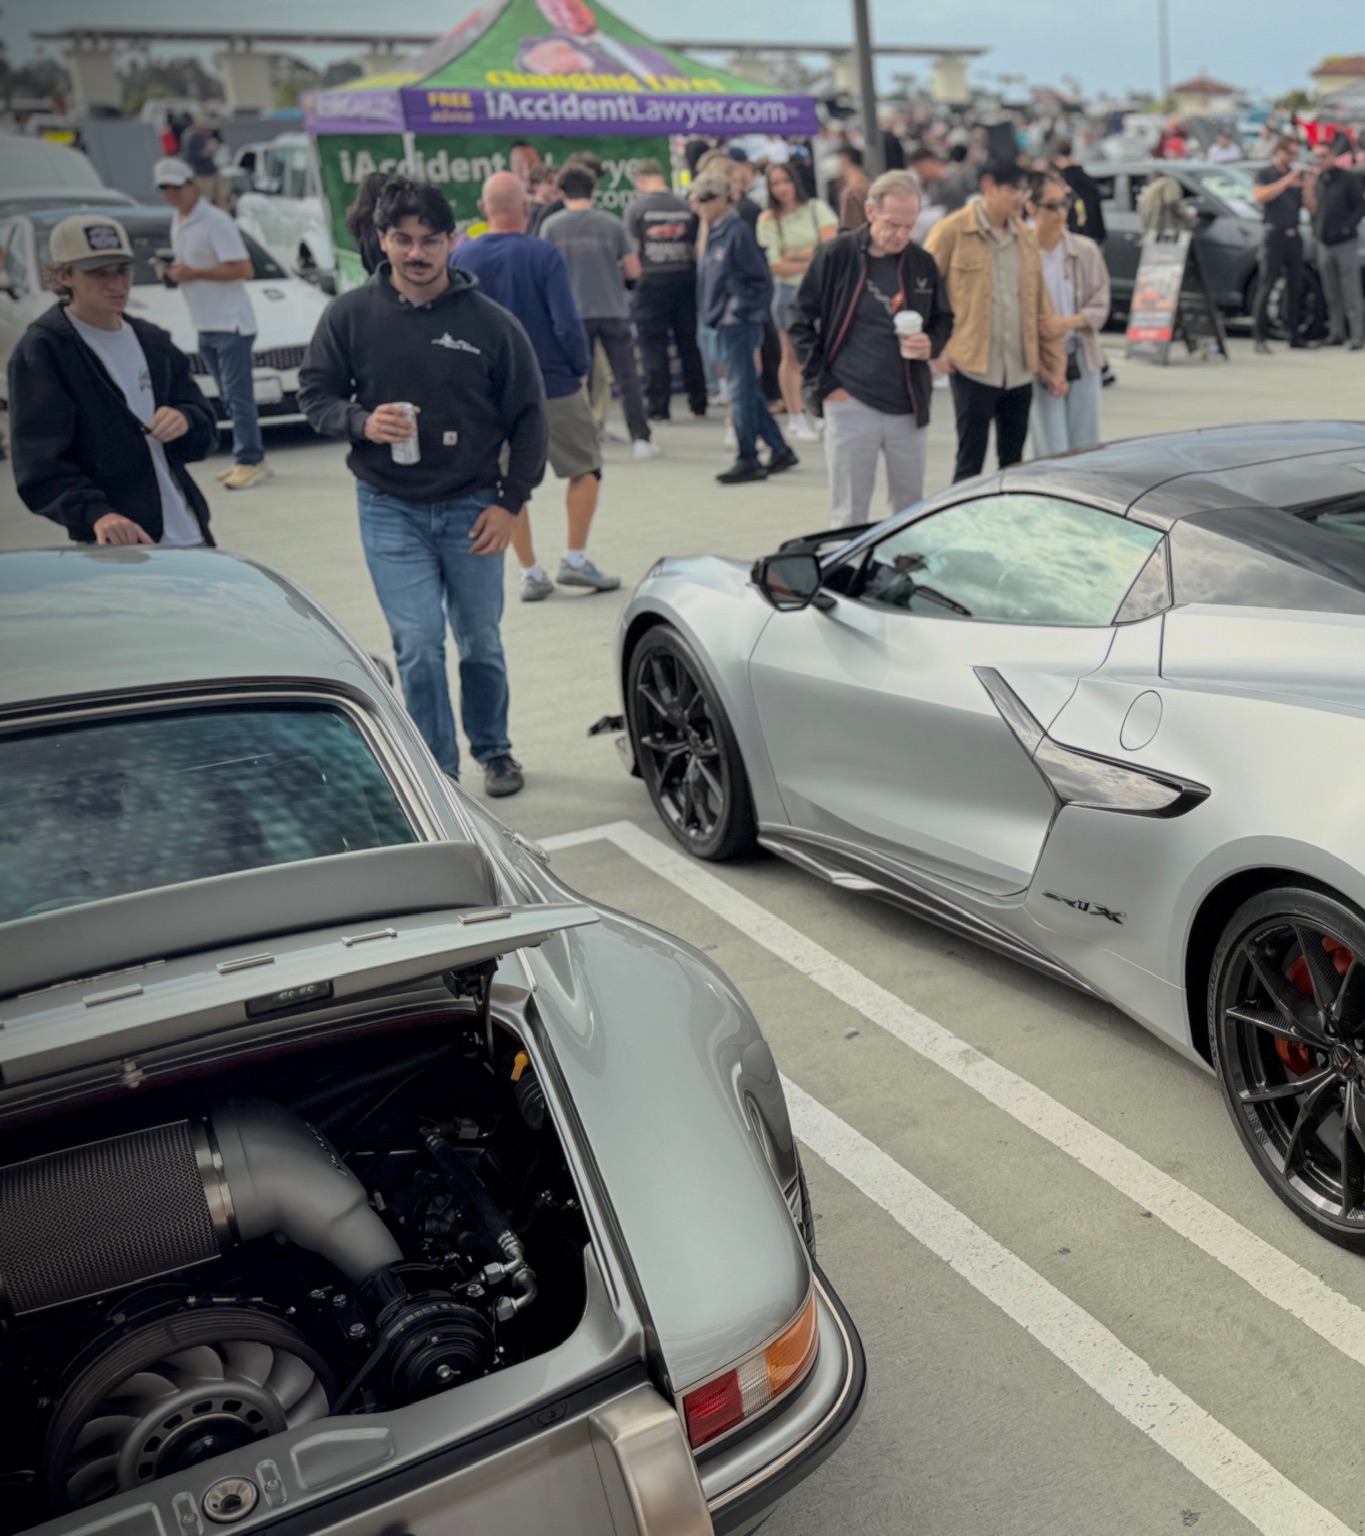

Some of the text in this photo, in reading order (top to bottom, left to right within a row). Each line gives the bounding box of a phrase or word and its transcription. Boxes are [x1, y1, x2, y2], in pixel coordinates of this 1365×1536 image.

[485, 70, 643, 93] Changing
[427, 92, 473, 108] FREE
[485, 91, 788, 129] iAccidentLawyer.com
